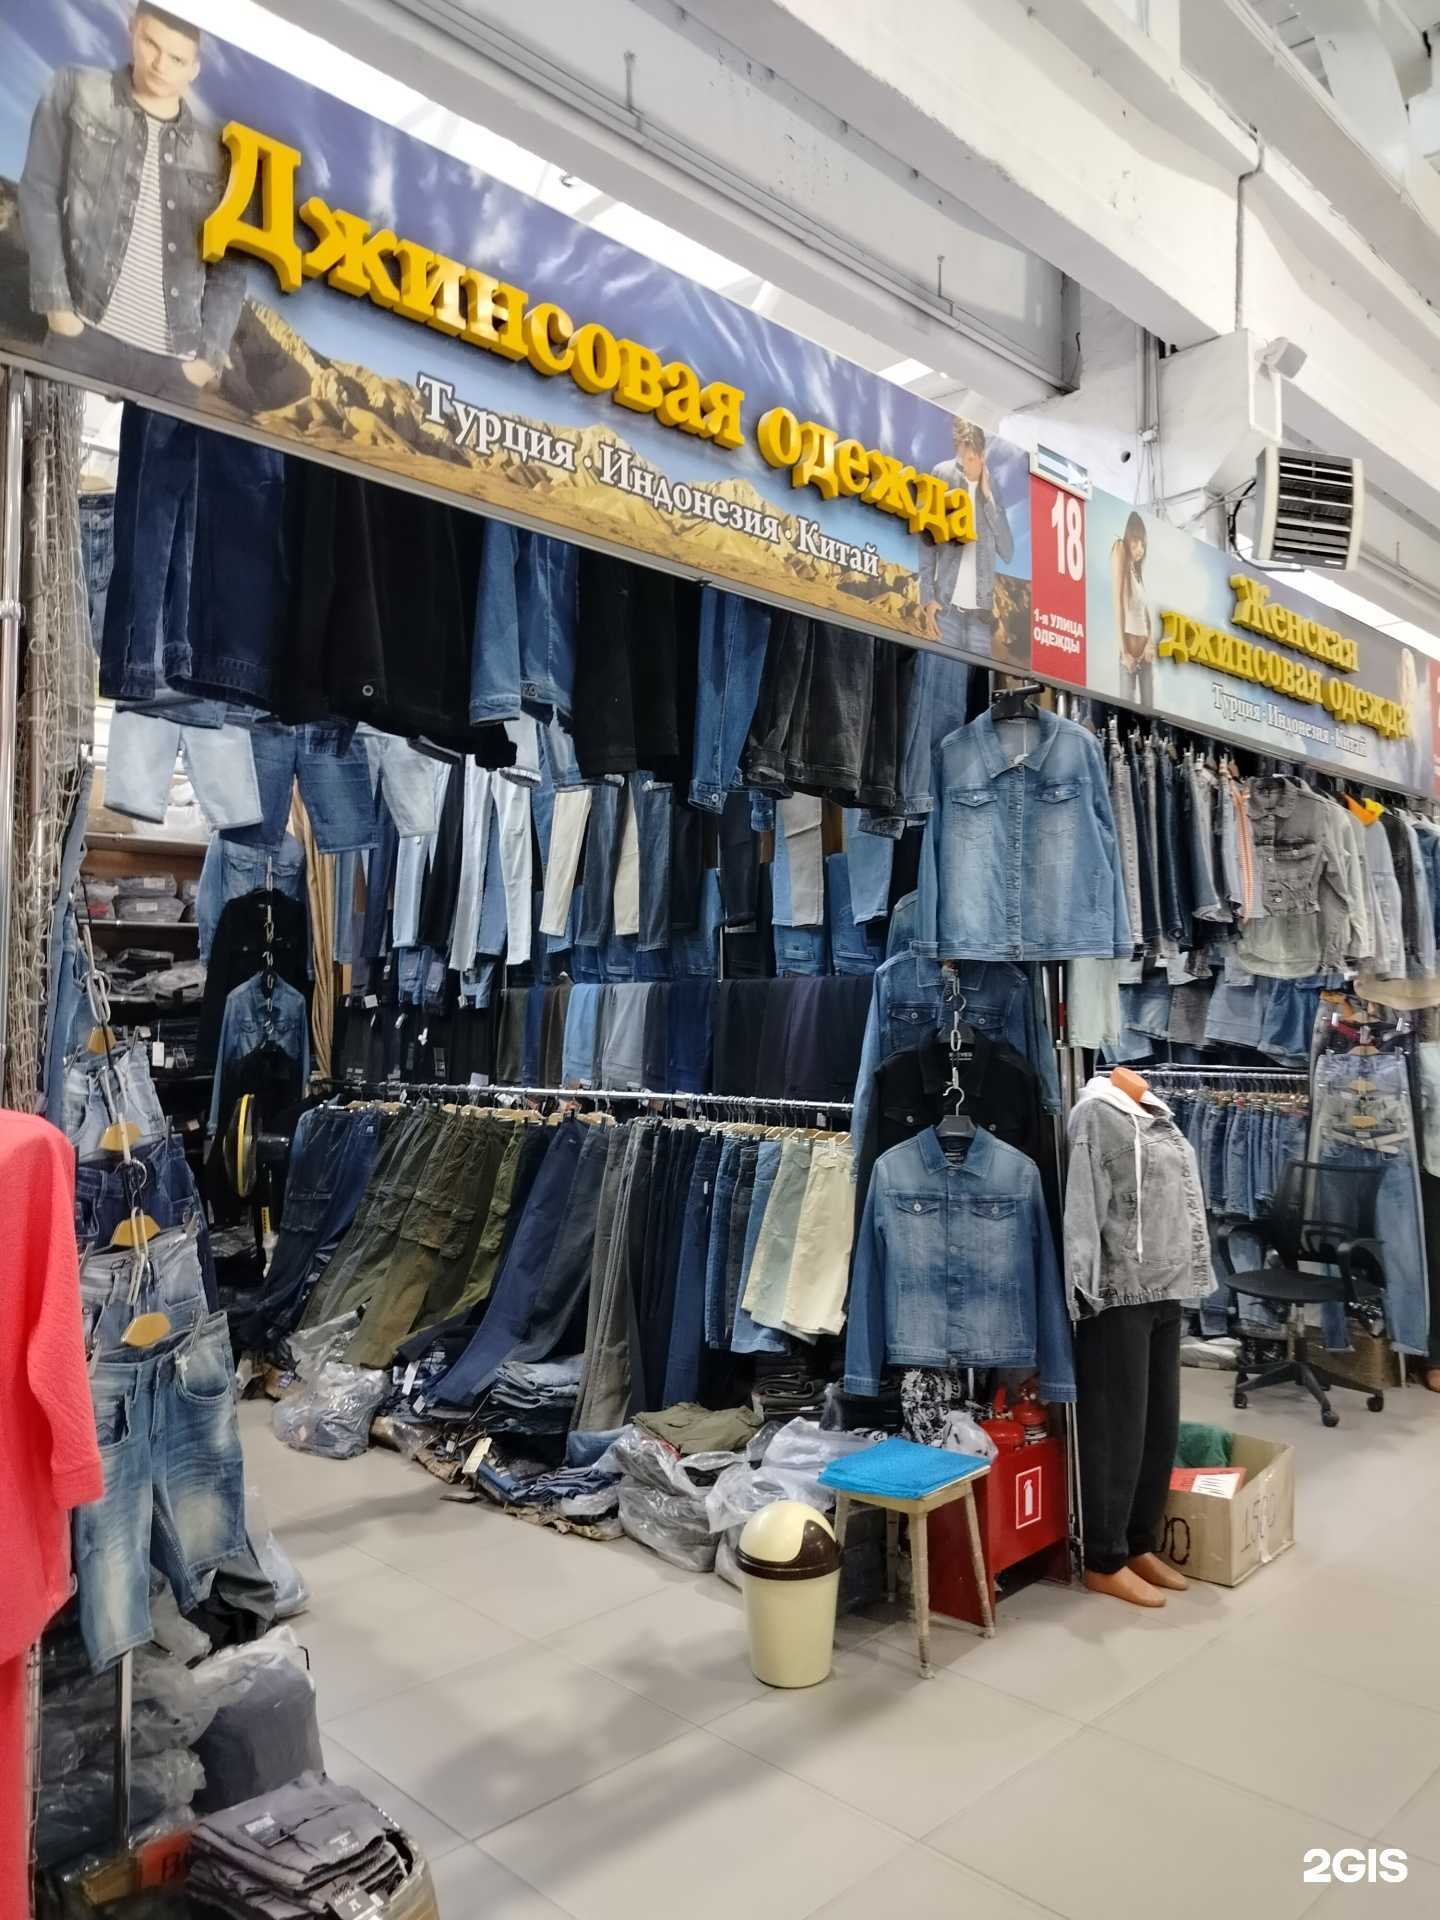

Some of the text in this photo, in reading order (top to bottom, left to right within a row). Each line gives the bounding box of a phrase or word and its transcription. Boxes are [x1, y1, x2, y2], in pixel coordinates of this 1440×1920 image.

[203, 120, 977, 545] Джинсовая одежда
[416, 371, 880, 578] Турция Индонезия Китай
[1051, 491, 1084, 582] 18
[1034, 627, 1080, 654] ОДЕЖДЫ
[1050, 613, 1085, 638] УЛИЦА
[1230, 573, 1360, 673] Женская
[1212, 682, 1262, 721] Турция
[1267, 703, 1329, 744] Индонезия
[1323, 677, 1409, 740] одежда
